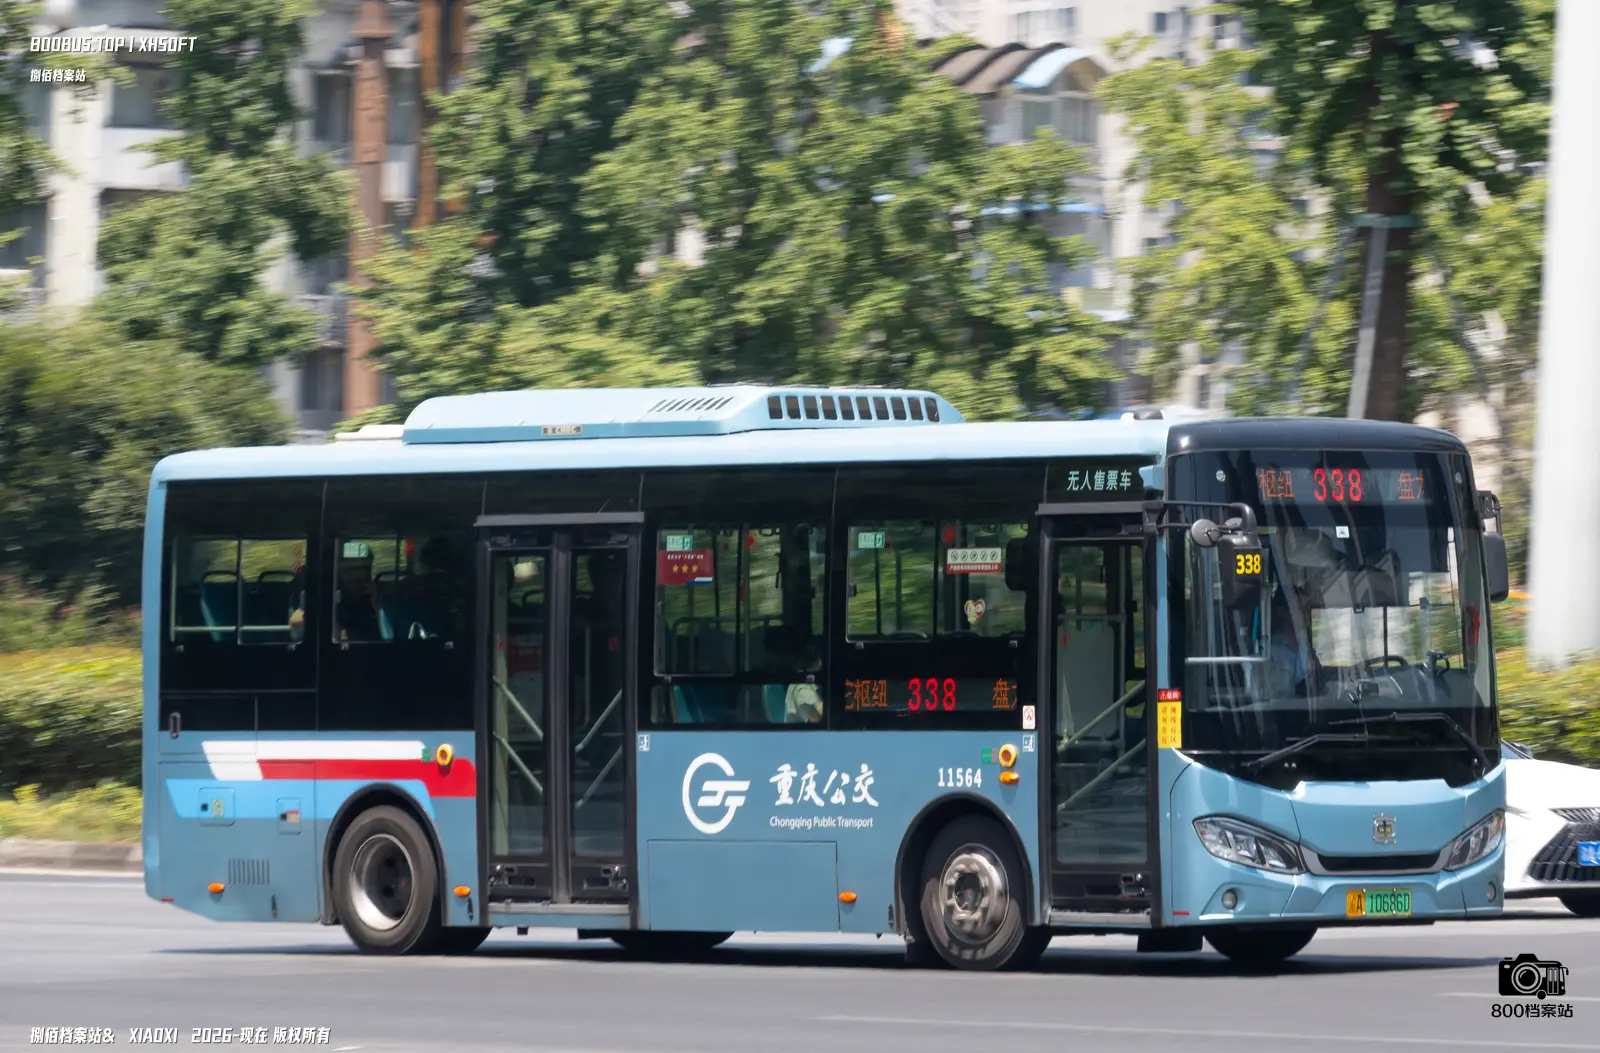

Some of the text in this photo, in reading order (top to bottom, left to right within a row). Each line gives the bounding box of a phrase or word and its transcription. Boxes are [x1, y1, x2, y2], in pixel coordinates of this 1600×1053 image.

[1066, 469, 1132, 491] 无人售票车
[1258, 467, 1295, 498] 枢纽
[1313, 468, 1362, 501] 338
[1235, 553, 1262, 575] 338
[908, 677, 957, 711] 338
[769, 763, 879, 807] 重庆公交
[937, 767, 983, 788] 11564
[769, 816, 873, 830] Chongqing Public Transport
